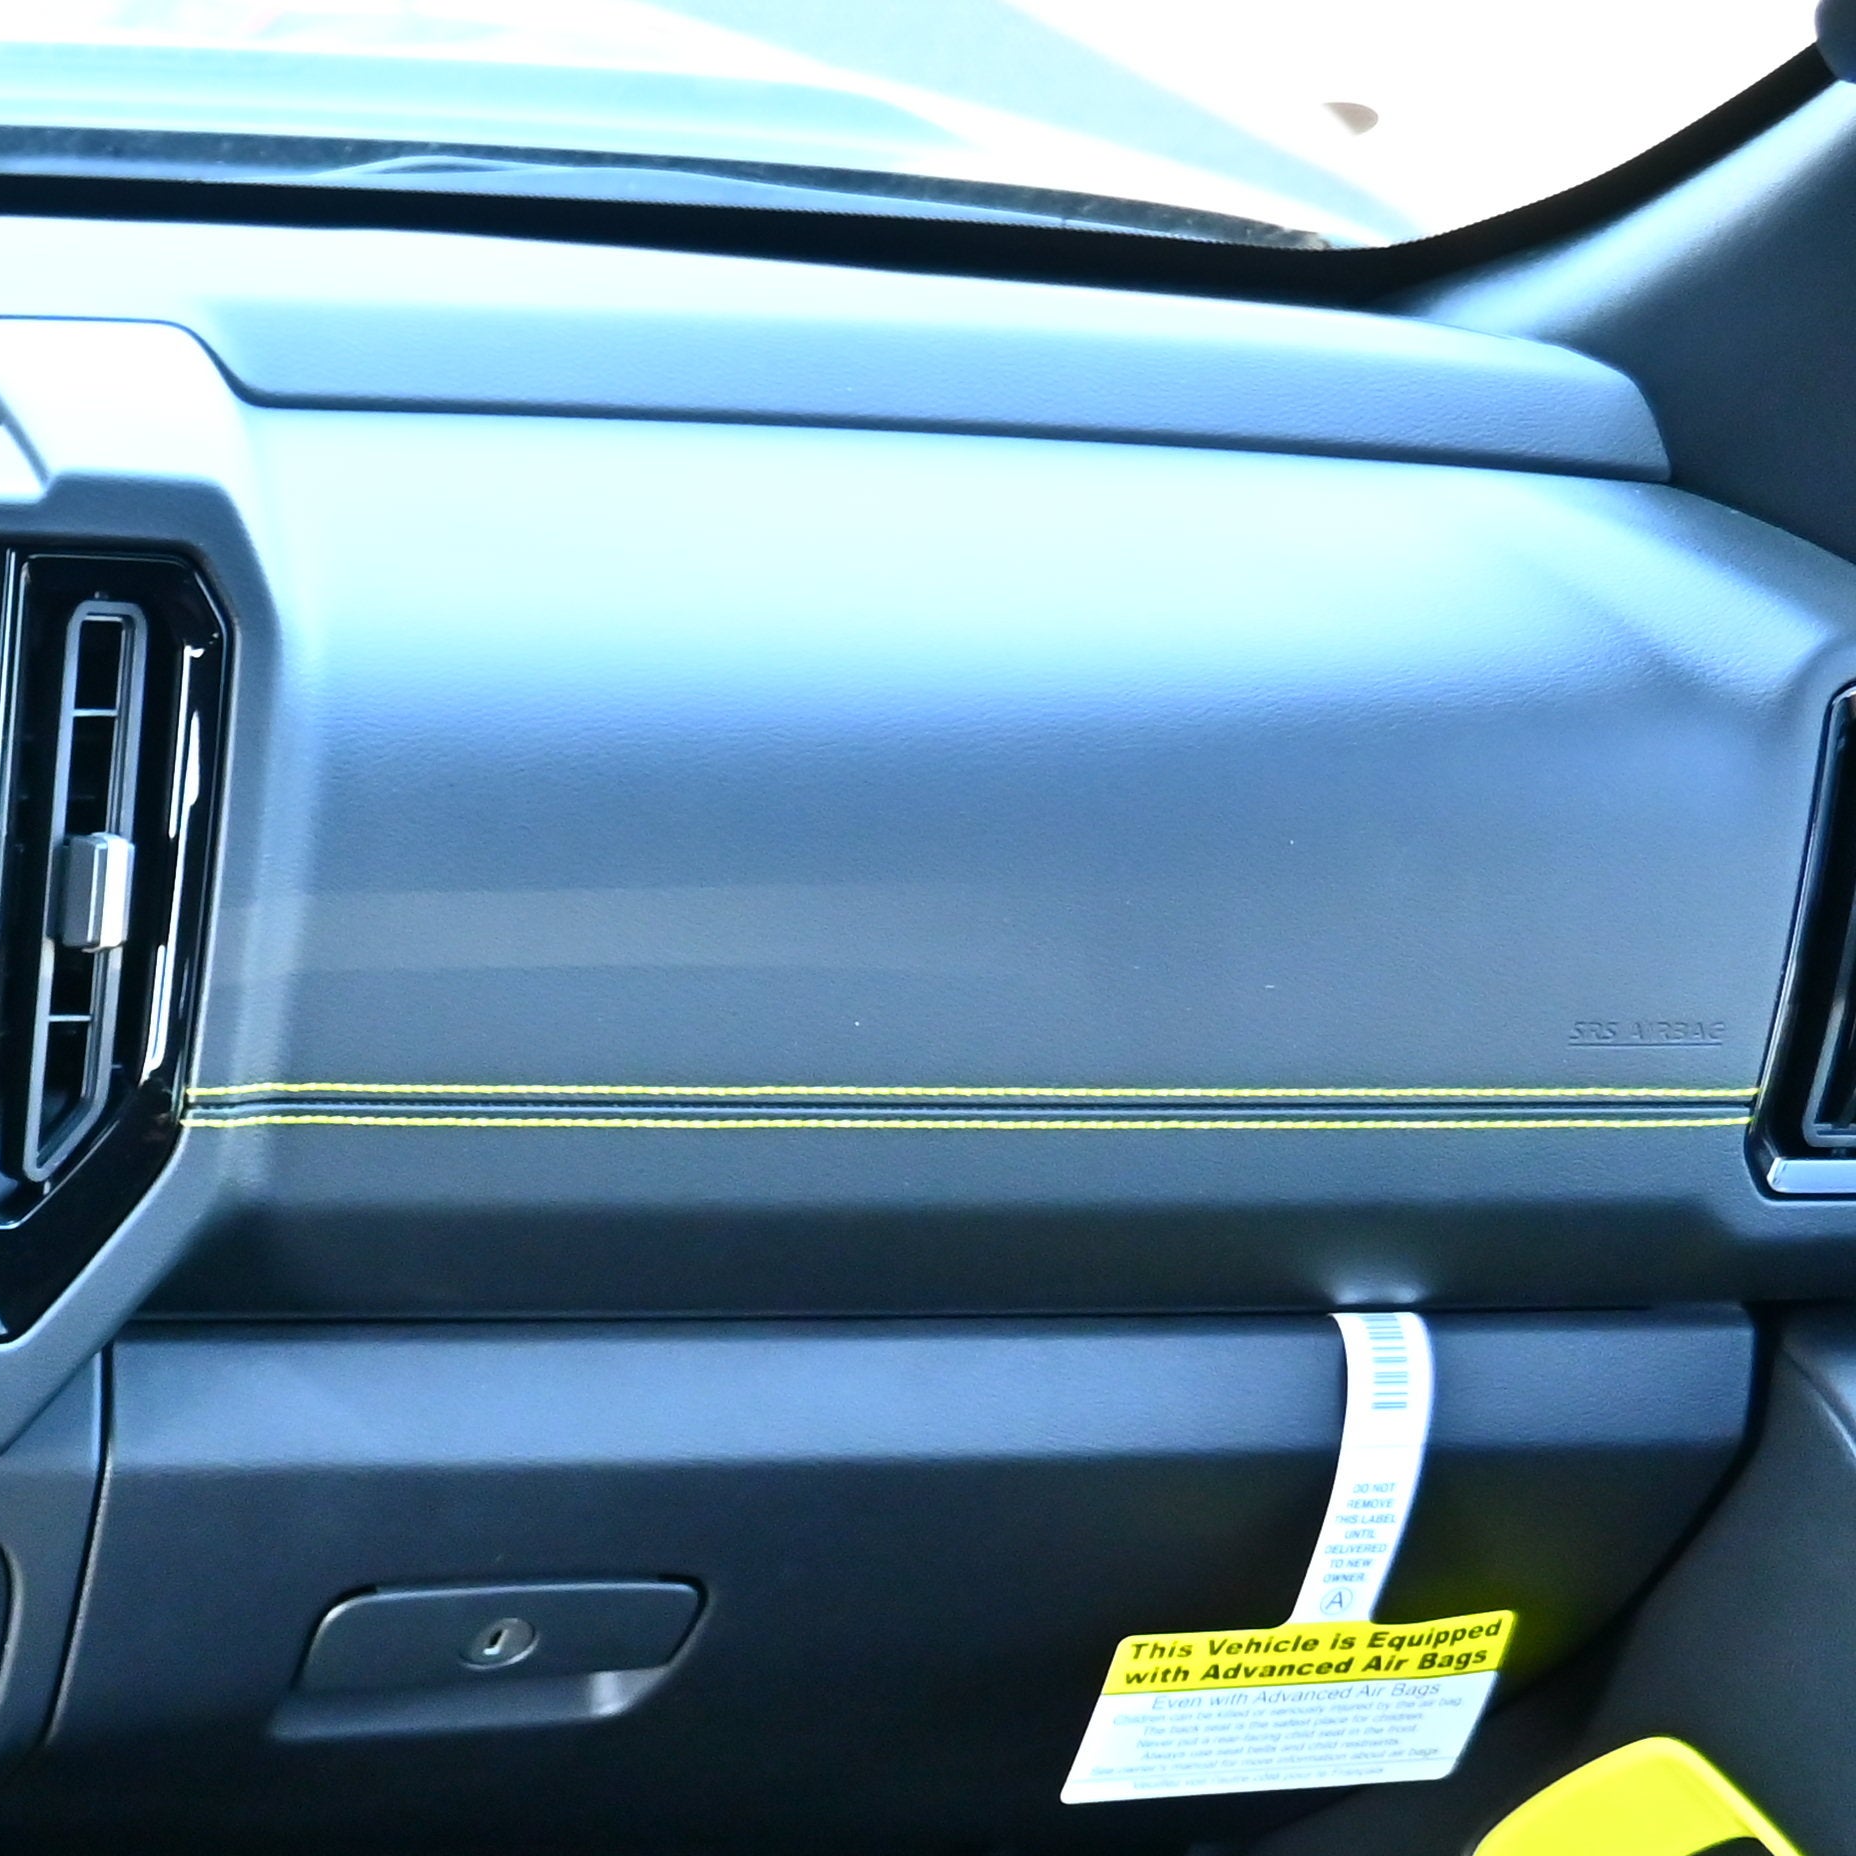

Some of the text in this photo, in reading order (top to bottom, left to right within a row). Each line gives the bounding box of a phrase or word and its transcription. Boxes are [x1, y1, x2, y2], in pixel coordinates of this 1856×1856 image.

[1325, 1591, 1343, 1610] A
[1132, 1618, 1502, 1659] This Vehicle is Equipped
[1125, 1649, 1488, 1685] with Advanced Air Bags
[1152, 1682, 1441, 1710] Even with Advanced Air Bags
